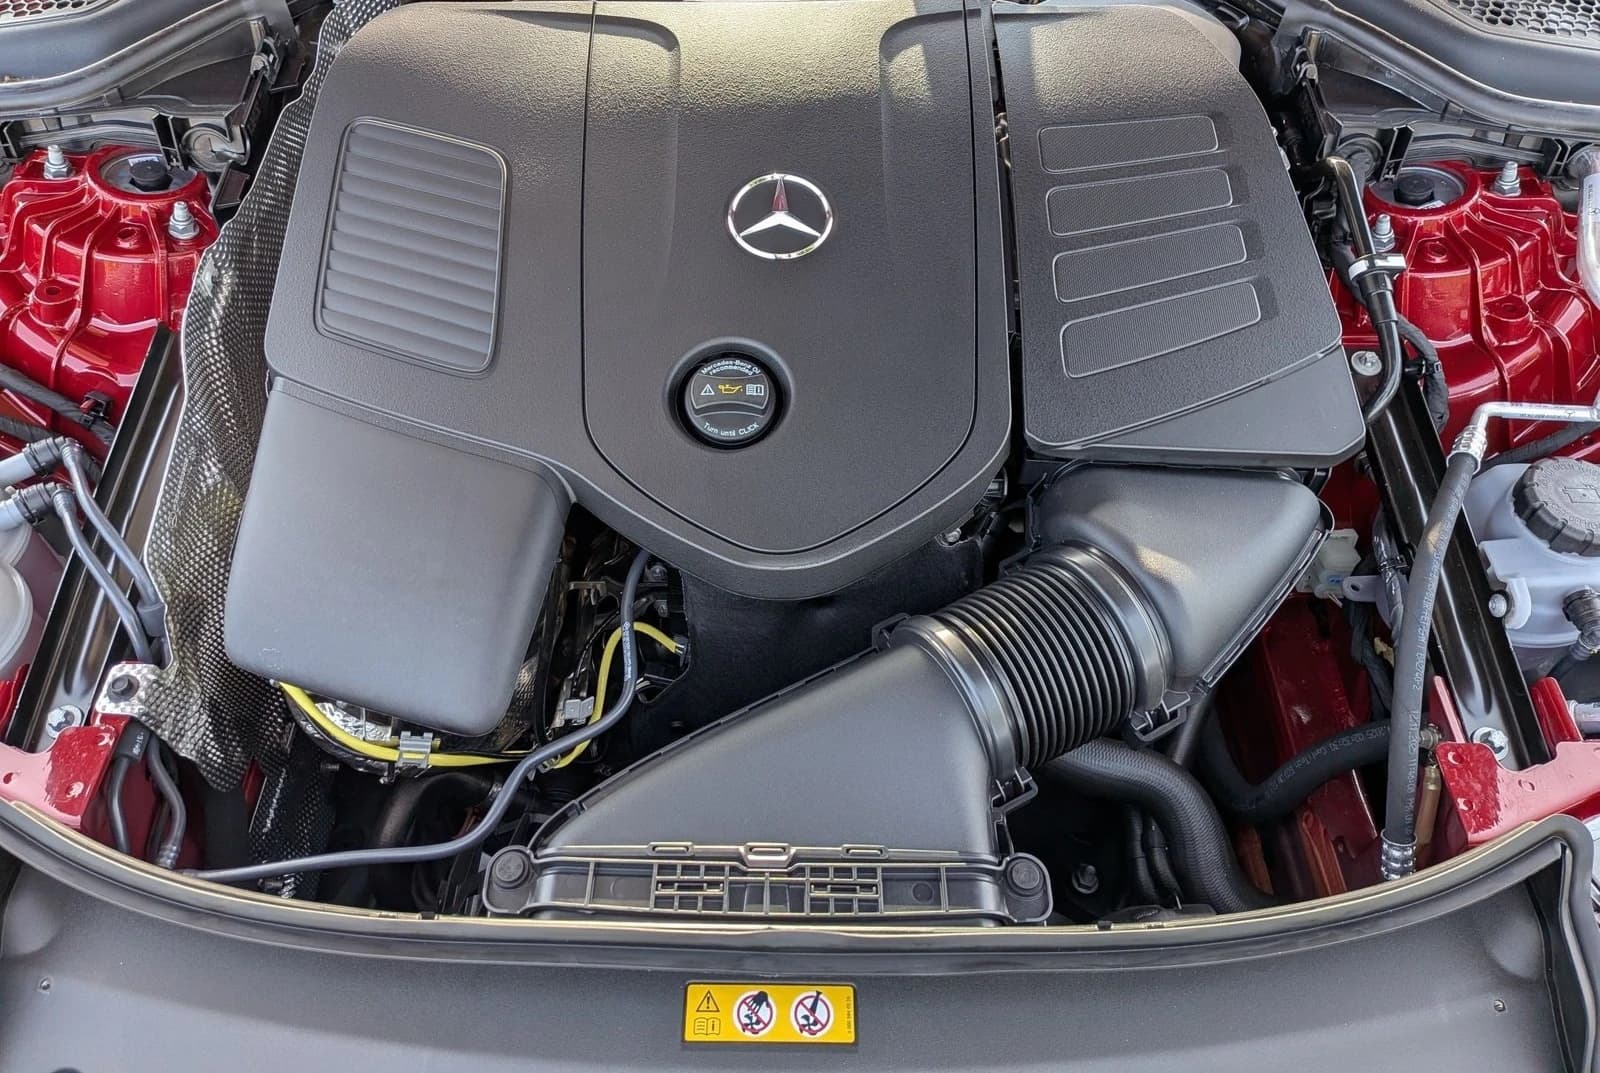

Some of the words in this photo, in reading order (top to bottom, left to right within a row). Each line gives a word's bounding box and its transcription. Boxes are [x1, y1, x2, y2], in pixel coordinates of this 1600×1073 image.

[701, 360, 752, 375] Mercedes-Benz
[709, 365, 754, 376] recommended
[703, 422, 718, 434] Turn
[720, 429, 736, 437] until
[738, 422, 760, 436] CLICK
